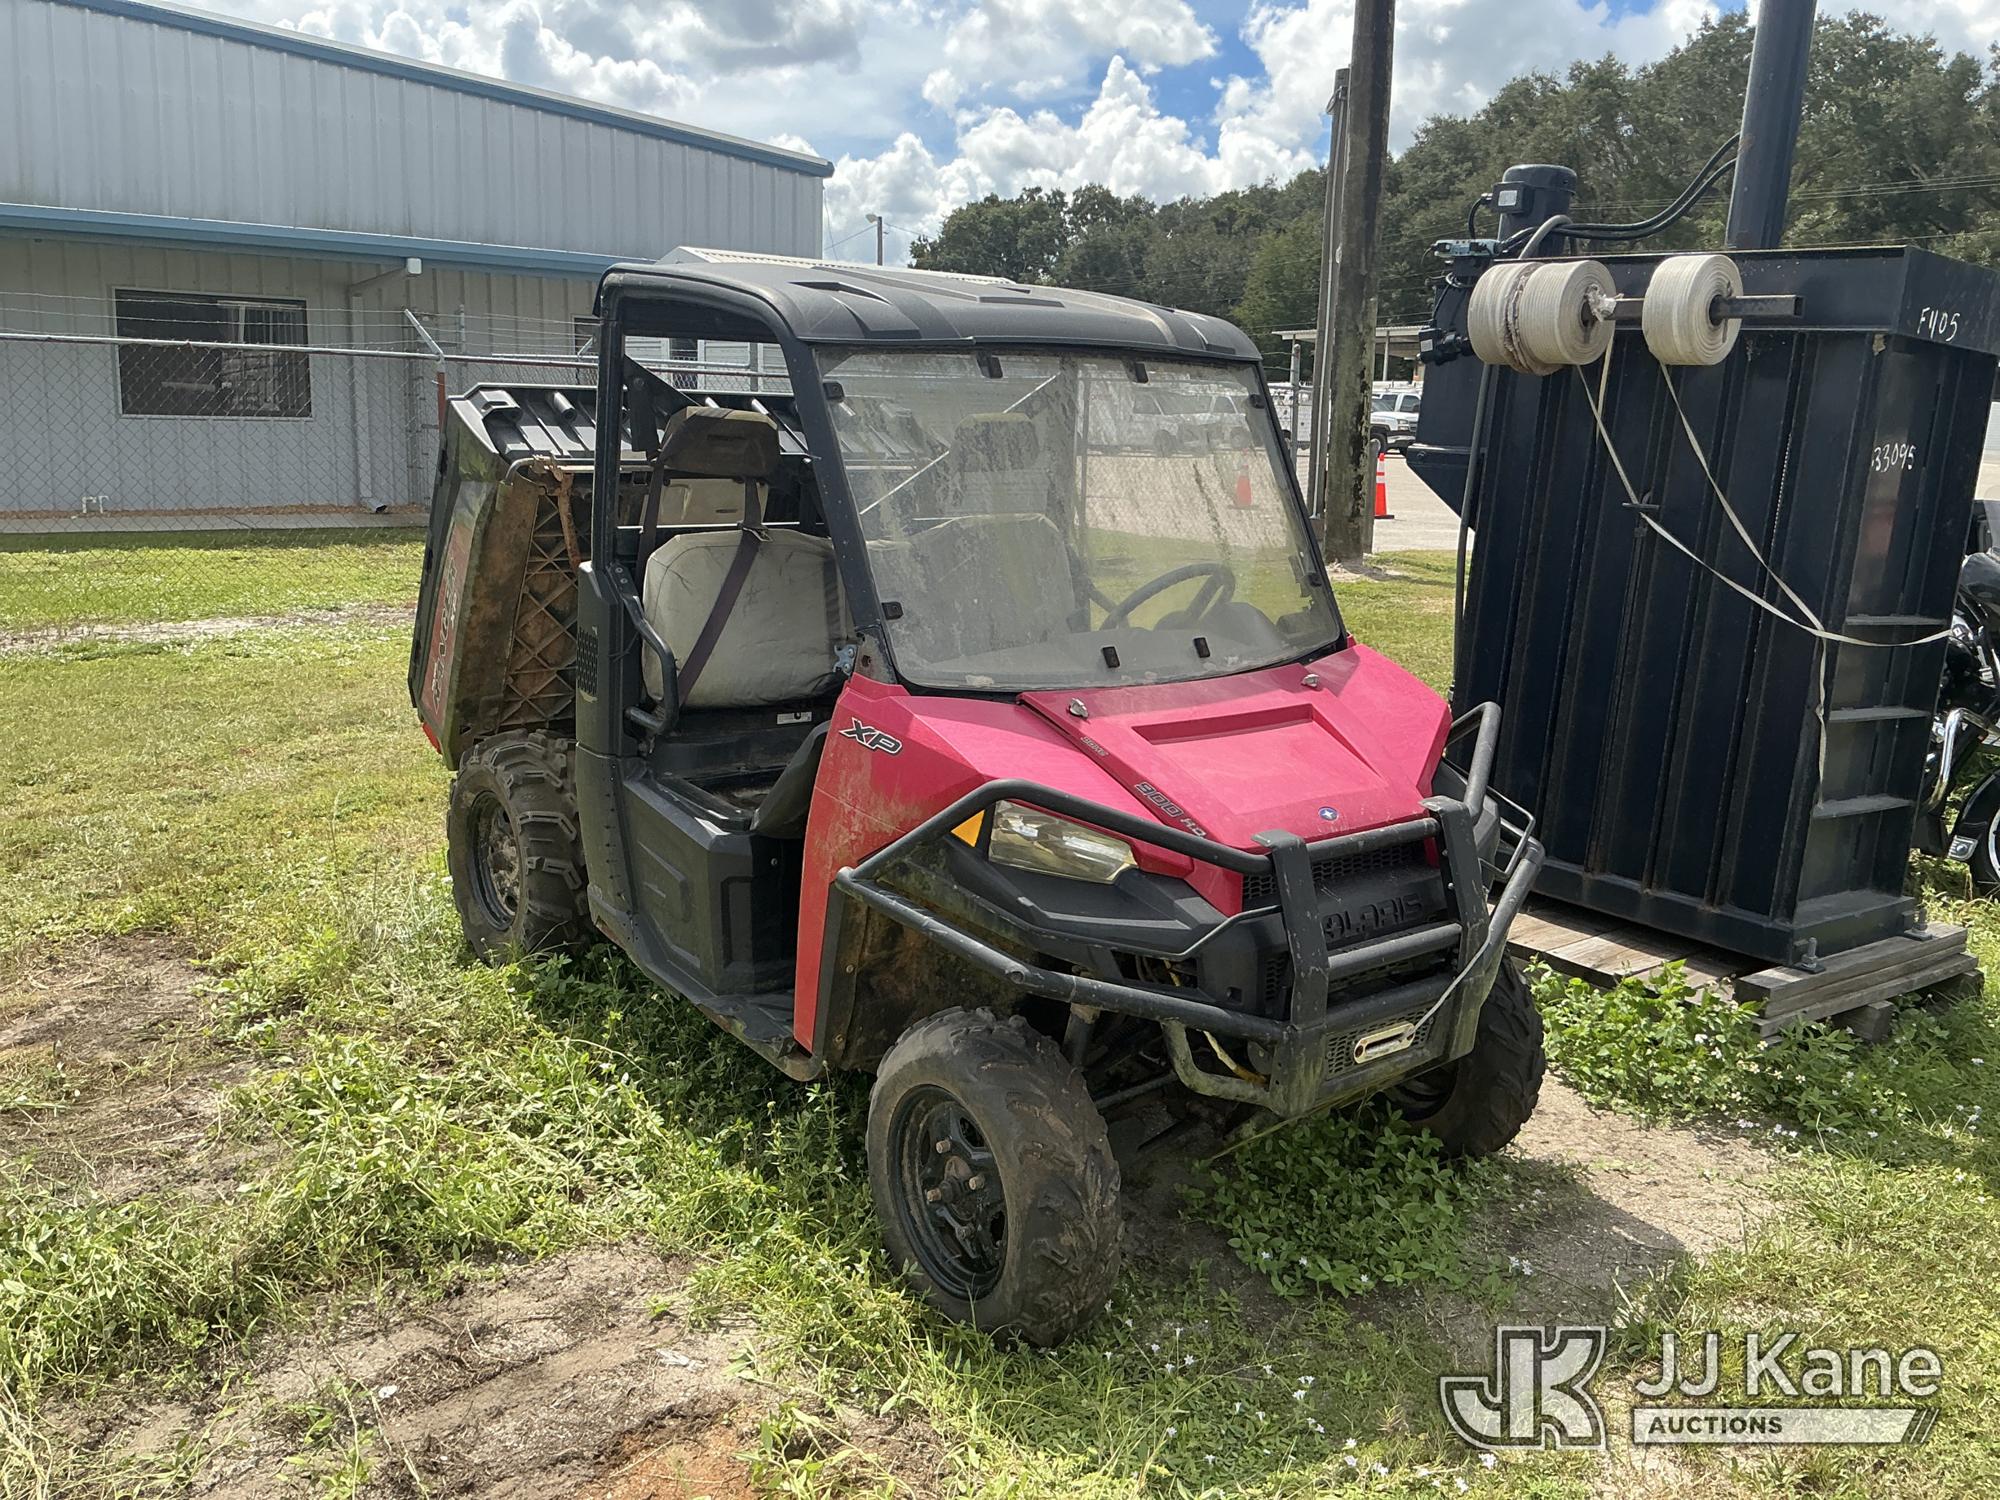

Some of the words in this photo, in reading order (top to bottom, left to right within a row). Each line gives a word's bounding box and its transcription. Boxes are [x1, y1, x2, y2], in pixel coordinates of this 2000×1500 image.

[838, 716, 903, 754] XP
[1134, 780, 1185, 818] 900
[1322, 892, 1424, 942] OLARIS
